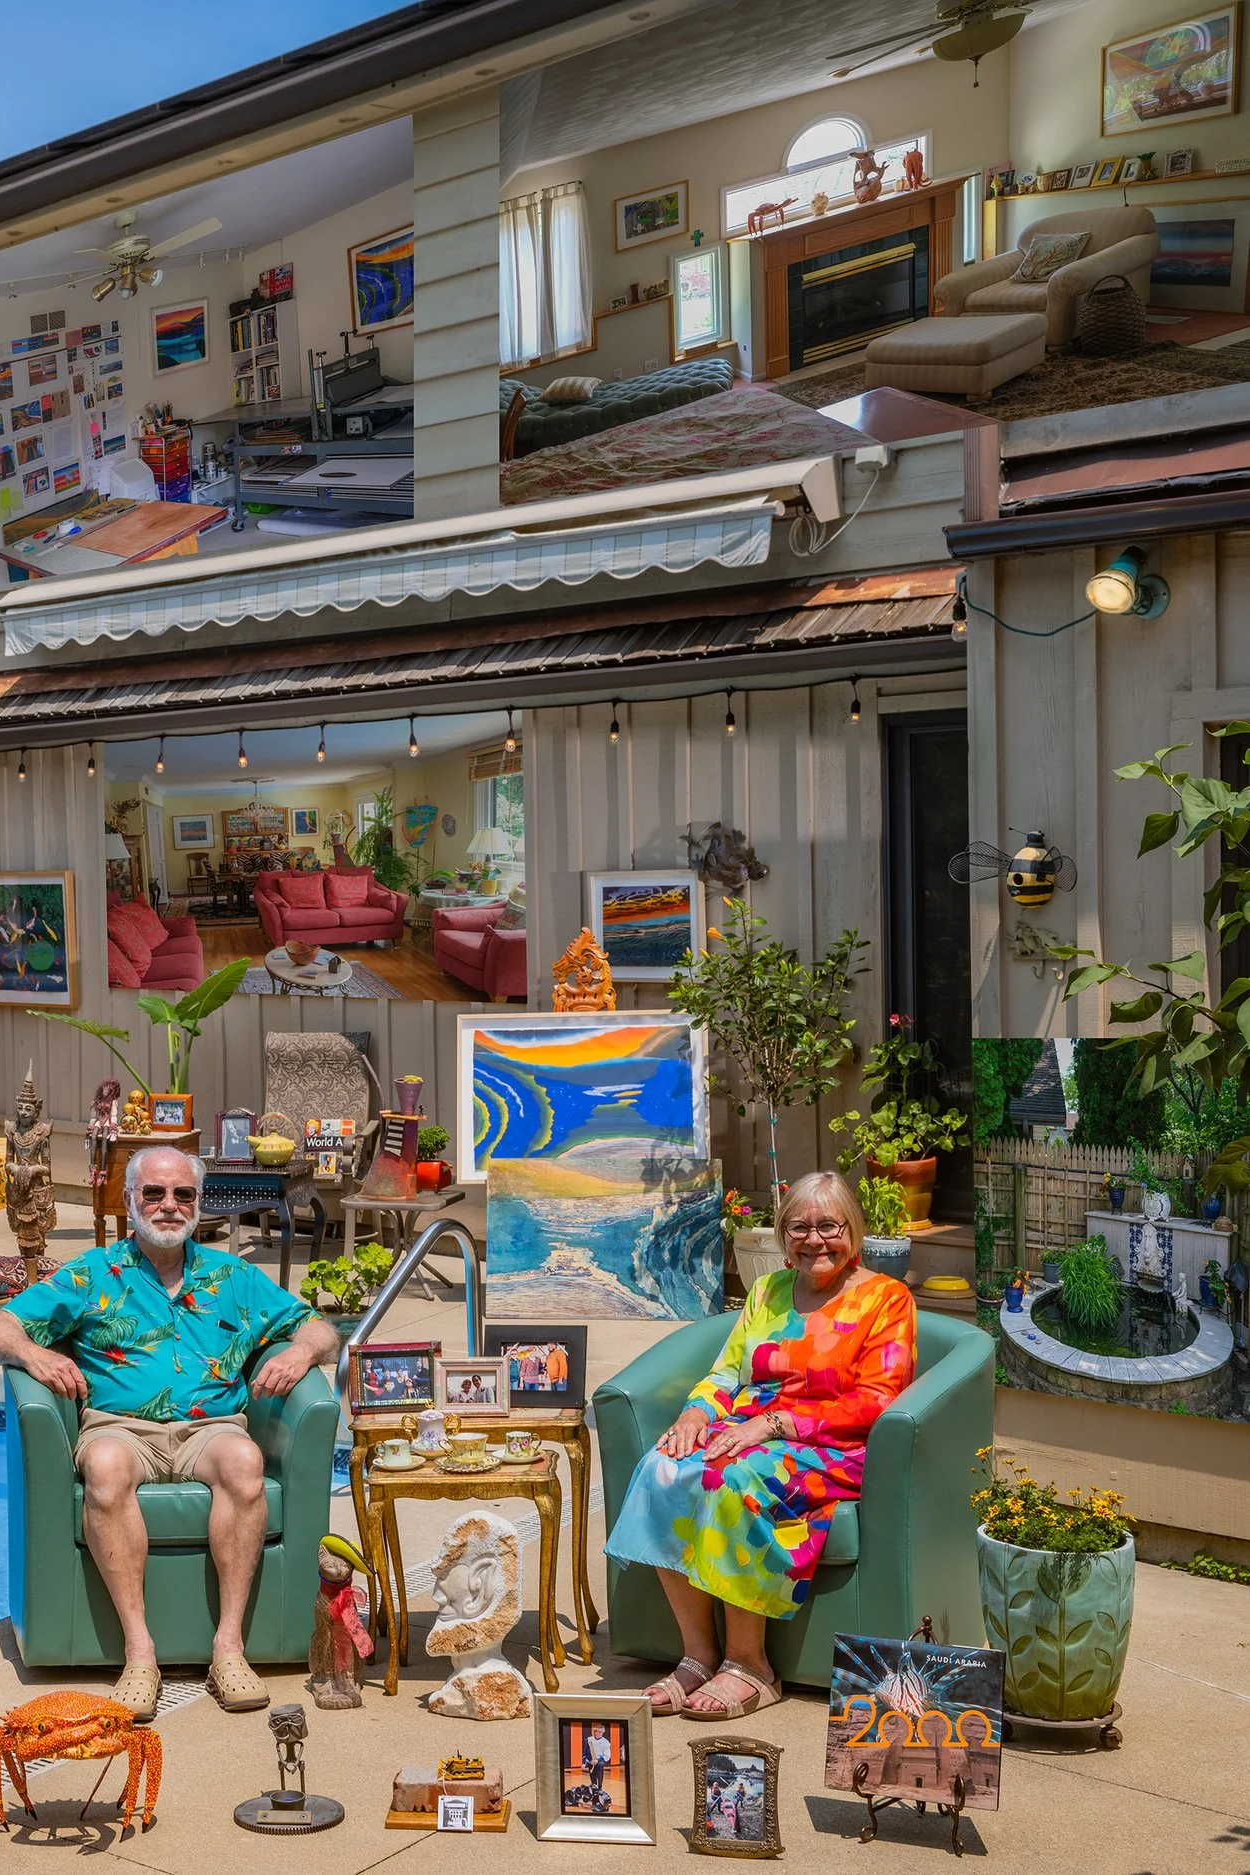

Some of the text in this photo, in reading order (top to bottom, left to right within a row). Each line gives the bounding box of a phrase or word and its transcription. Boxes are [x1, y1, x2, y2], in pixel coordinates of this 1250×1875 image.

[306, 1137, 343, 1147] World A
[926, 1654, 987, 1669] SAUDI ARABIA
[829, 1694, 1001, 1748] 2000
